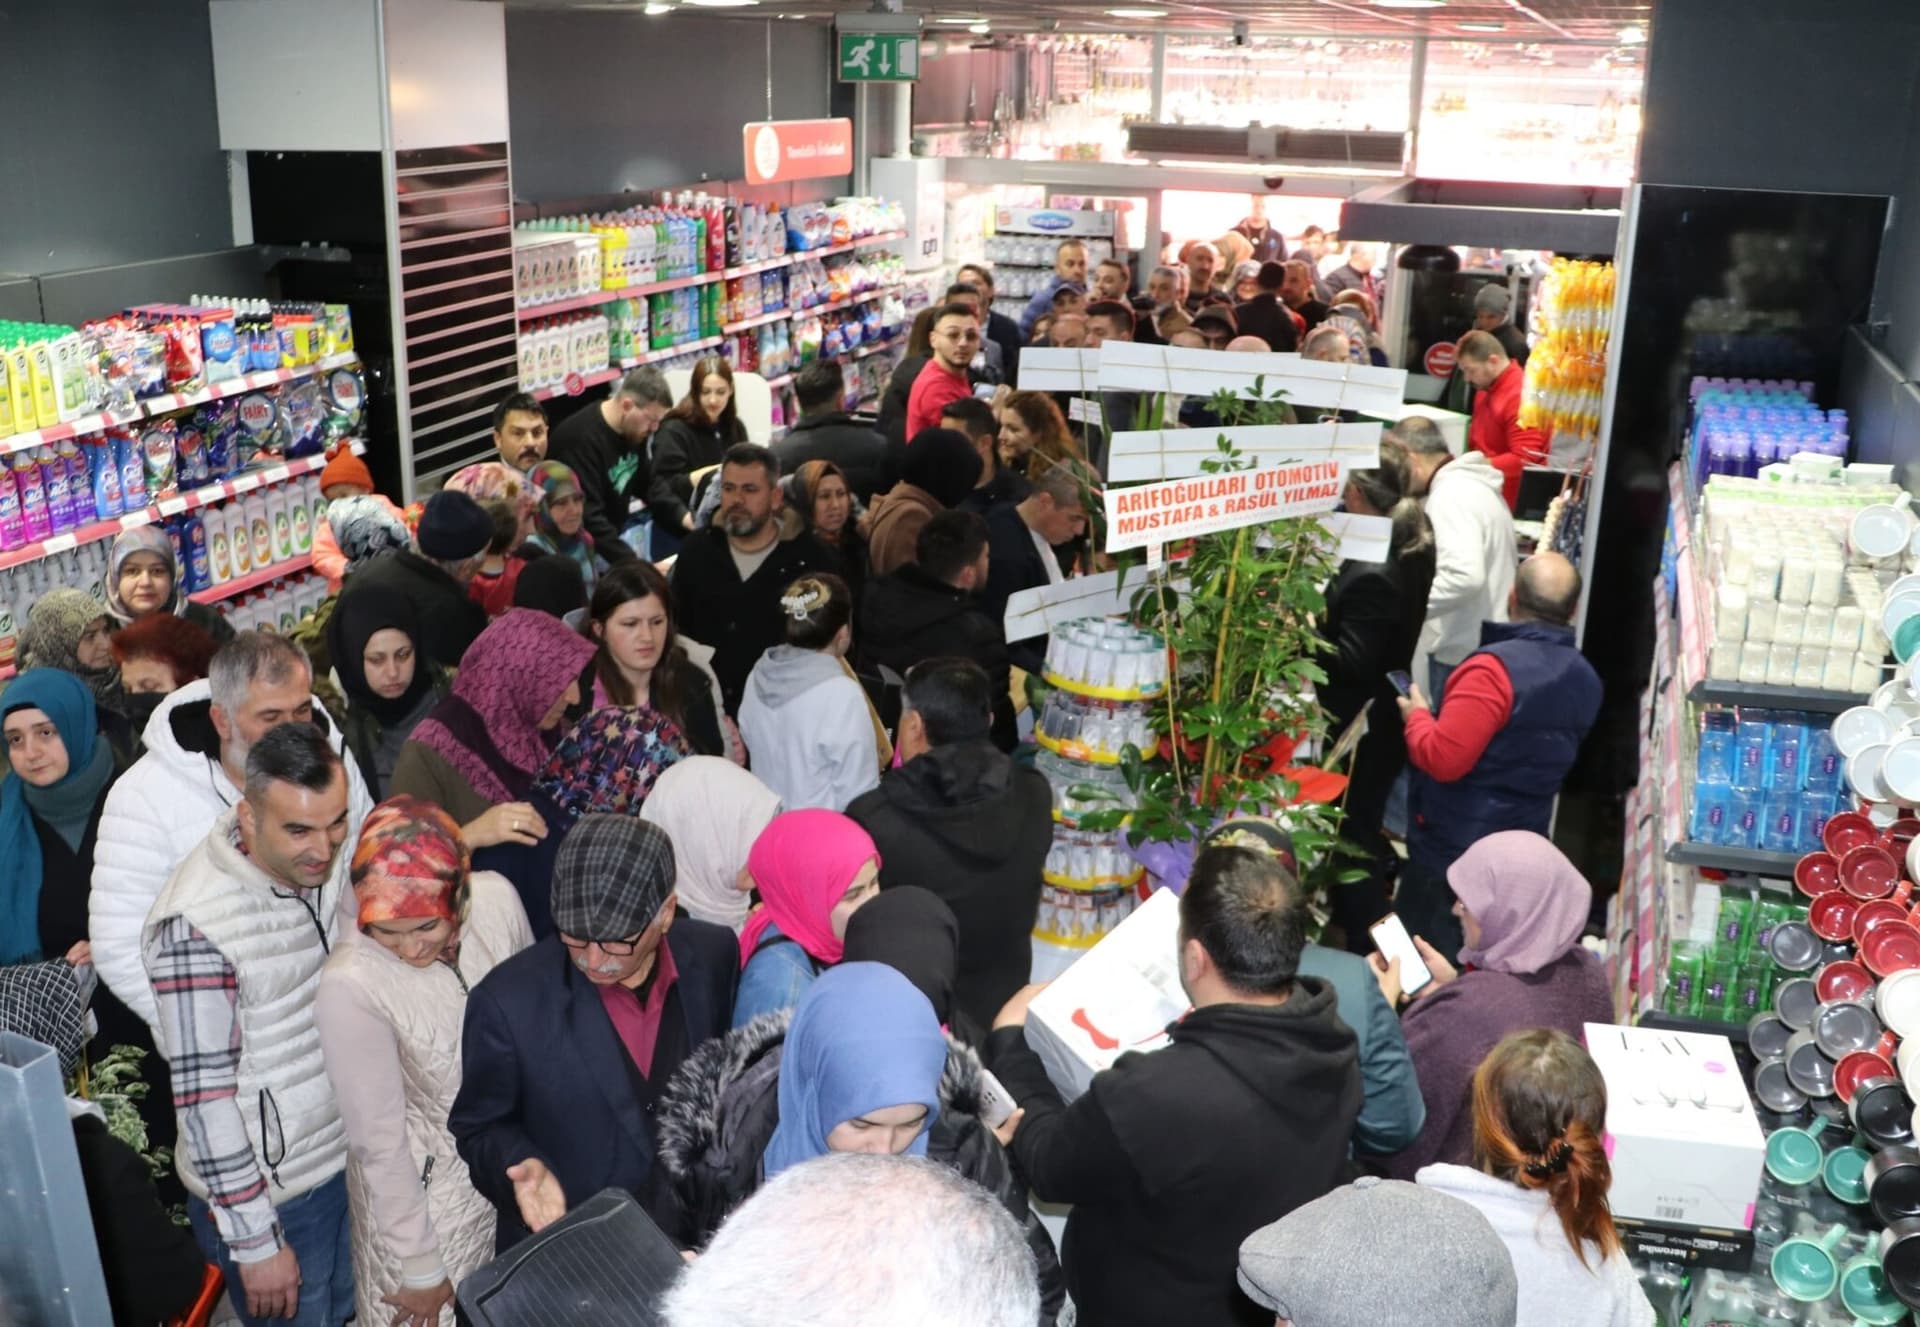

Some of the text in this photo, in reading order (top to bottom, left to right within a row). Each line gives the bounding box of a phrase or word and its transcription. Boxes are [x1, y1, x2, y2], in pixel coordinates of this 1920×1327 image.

[1116, 504, 1204, 535] MUSTAFA
[1208, 503, 1220, 518] &
[1224, 489, 1278, 515] RASÜL
[1282, 481, 1340, 505] YILMAZ
